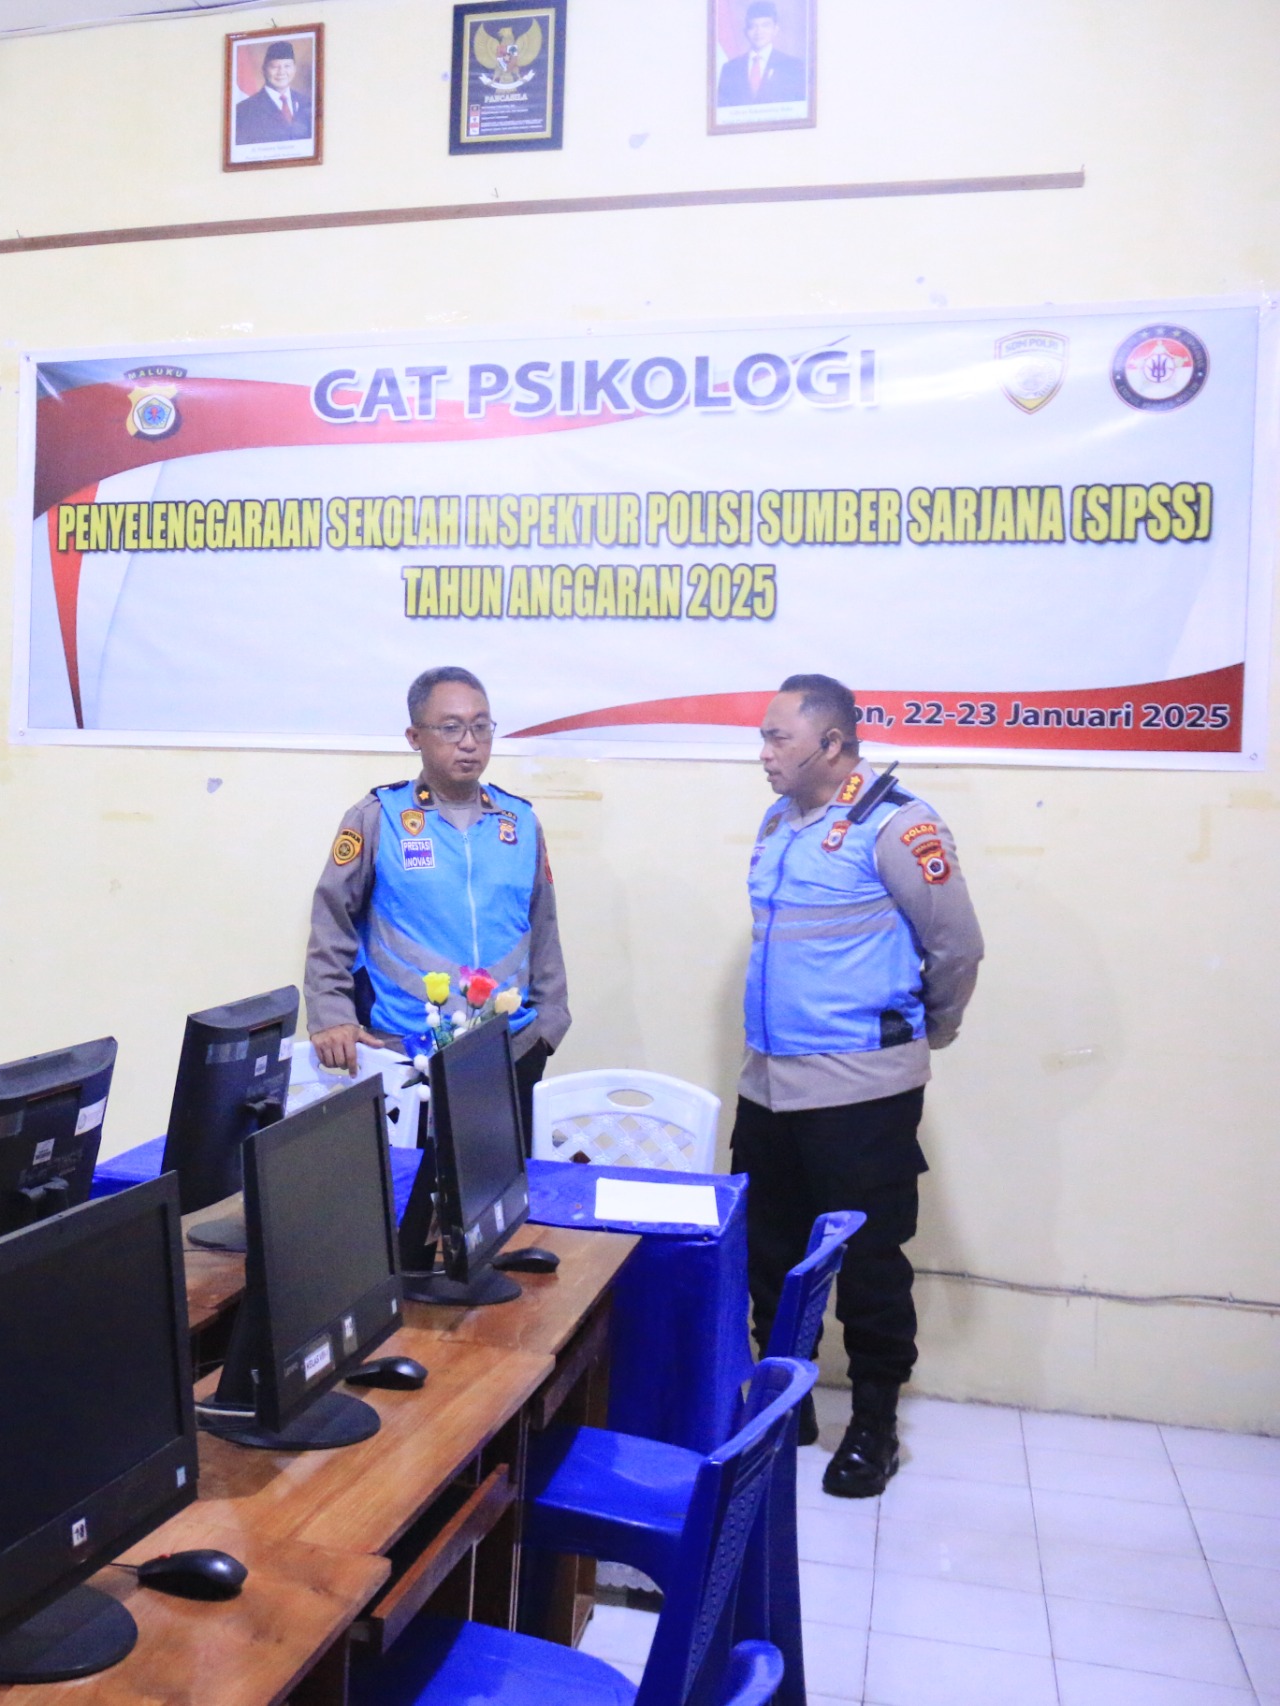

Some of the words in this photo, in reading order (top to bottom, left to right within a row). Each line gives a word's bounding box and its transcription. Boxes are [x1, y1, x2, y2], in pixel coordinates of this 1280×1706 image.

[127, 367, 183, 380] MALUKU
[313, 363, 447, 422] CAT
[466, 349, 876, 419] PSIKOLOGI
[57, 499, 321, 553] PENYELENGGARAAN
[327, 495, 460, 550] SEKOLAH
[466, 492, 639, 547] INSPEKTUR
[646, 490, 752, 546] POLISI
[758, 487, 901, 545] SUMBER
[908, 485, 1065, 543] SARJANA
[1071, 482, 1212, 542] (SIPSS)
[402, 565, 503, 618] TAHUN
[507, 564, 681, 618] ANGGARAN
[686, 563, 776, 619] 2025
[903, 702, 997, 727] 22-23
[1004, 702, 1133, 728] Januari
[1140, 703, 1231, 729] 2025
[903, 824, 935, 842] POLDA
[403, 841, 431, 850] PRESTASI
[405, 857, 433, 868] INOVASI
